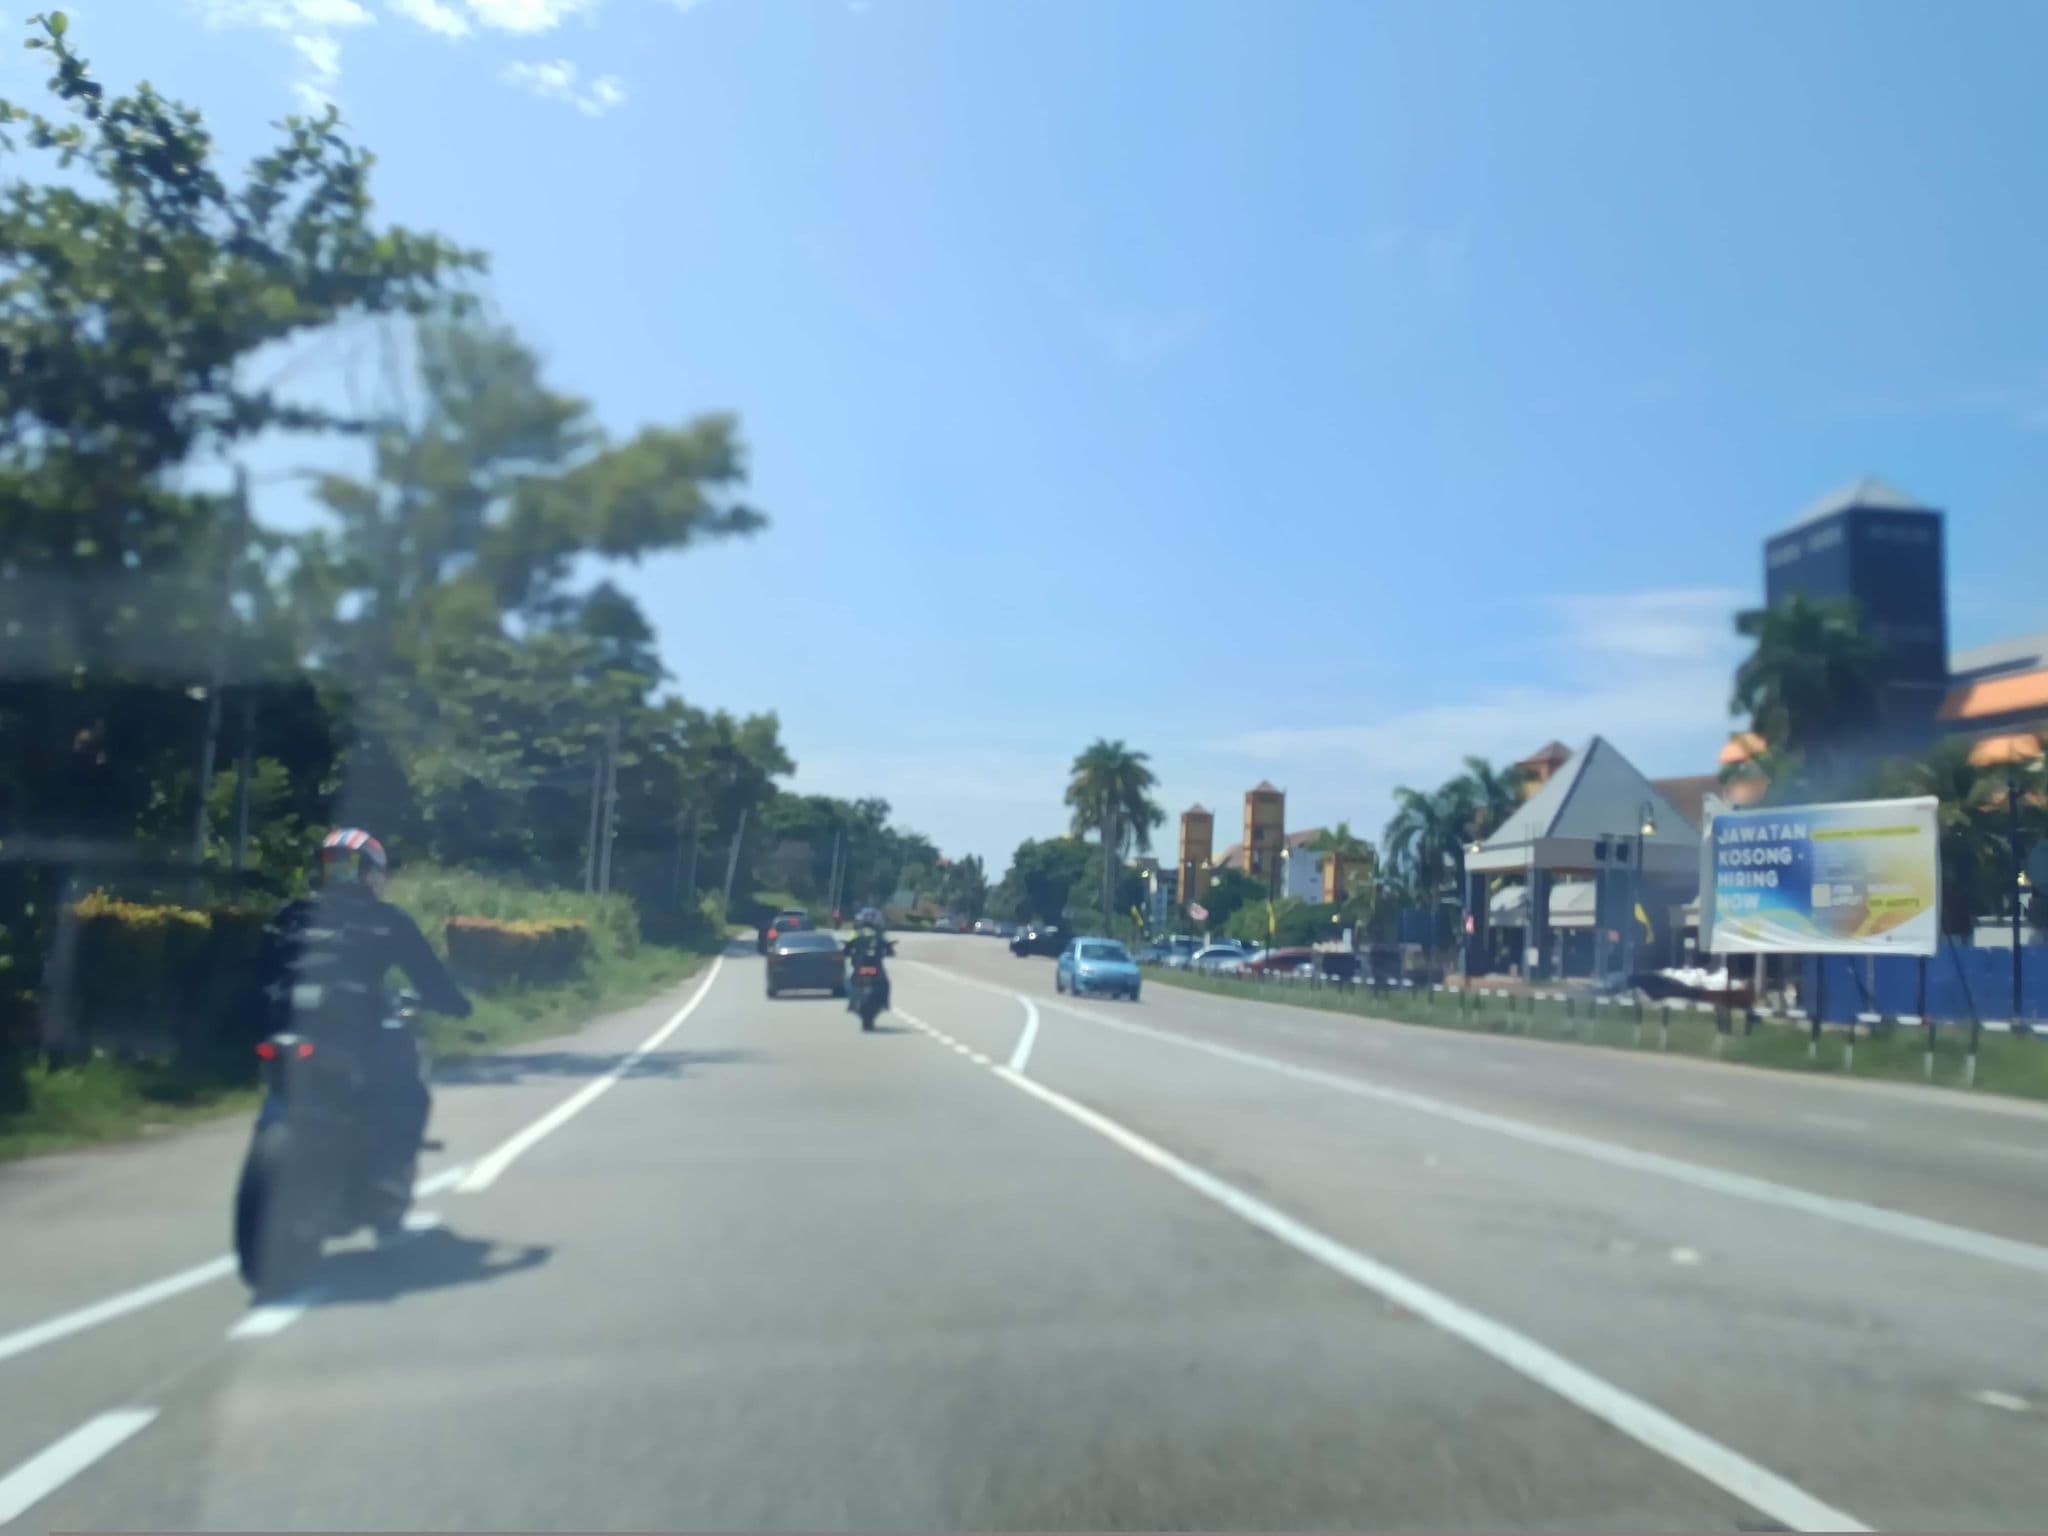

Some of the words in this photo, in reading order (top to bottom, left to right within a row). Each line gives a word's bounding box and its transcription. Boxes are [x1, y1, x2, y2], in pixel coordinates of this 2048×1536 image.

[1718, 824, 1807, 844] JAWATAN
[1718, 847, 1792, 866] KOSONG
[1718, 870, 1779, 888] HIRING
[1717, 894, 1760, 911] NOW
